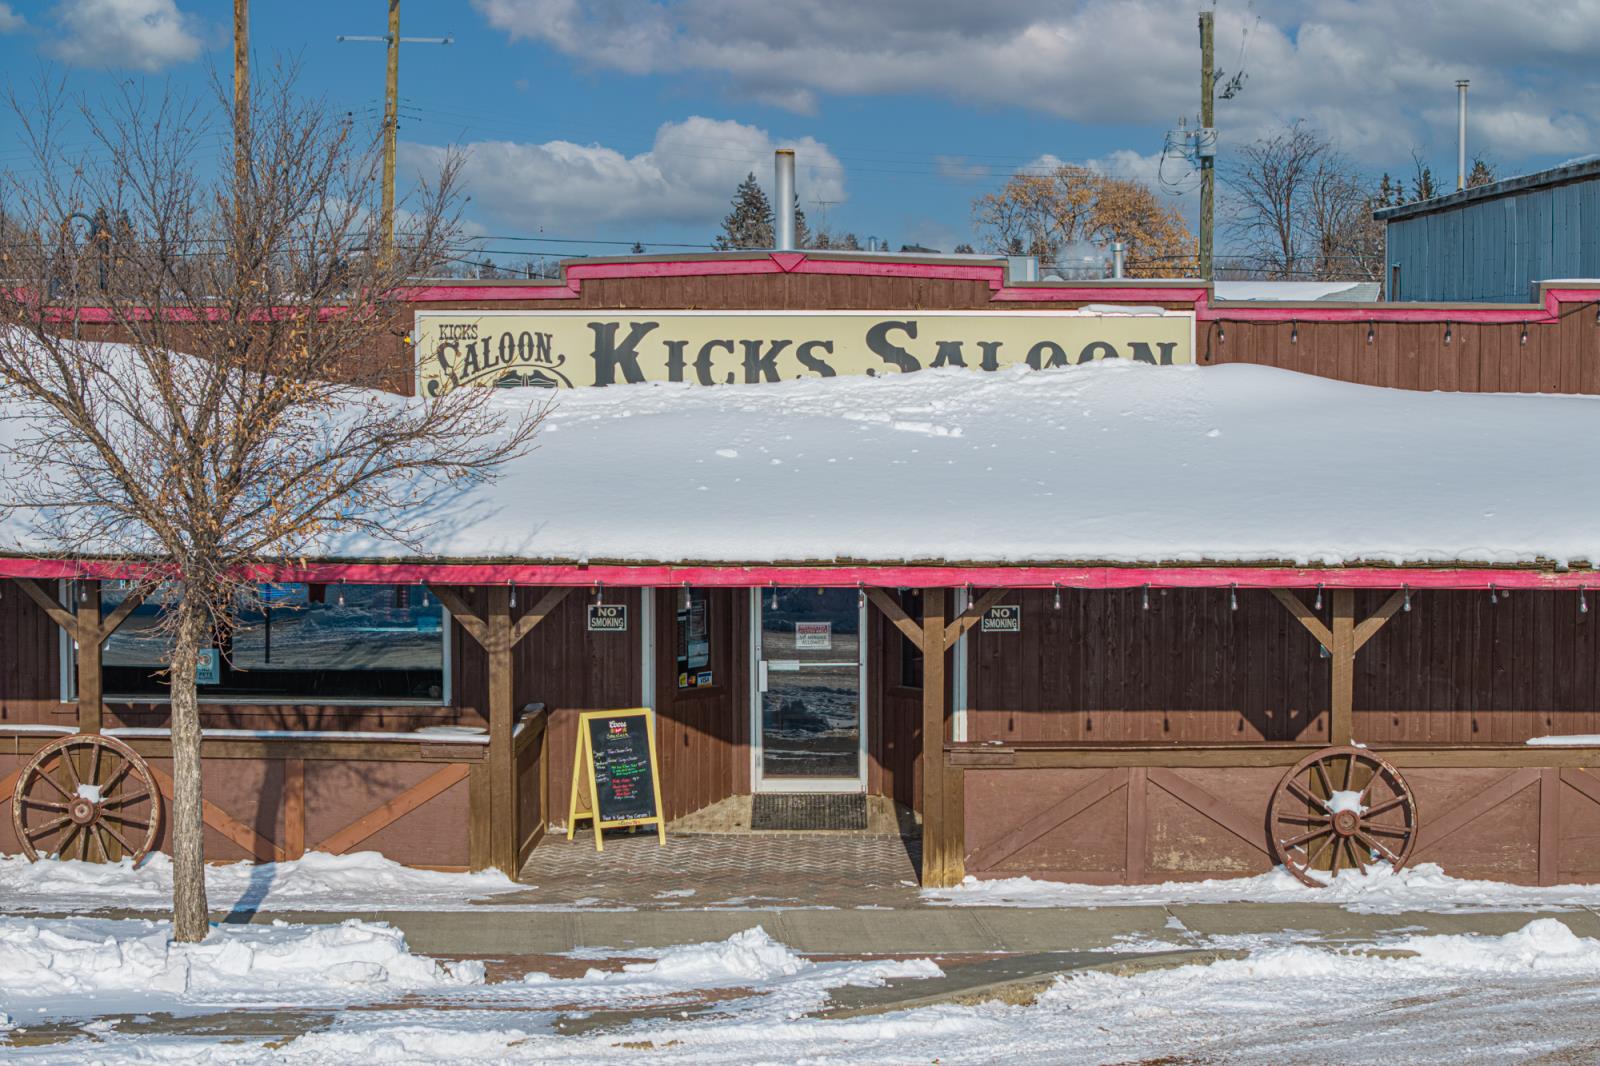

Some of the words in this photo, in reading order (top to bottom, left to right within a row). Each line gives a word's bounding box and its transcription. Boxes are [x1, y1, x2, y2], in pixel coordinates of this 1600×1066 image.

[438, 324, 479, 341] KICKS
[586, 321, 837, 388] KICKS
[432, 331, 554, 391] SALOON
[597, 607, 617, 617] NO
[991, 608, 1010, 618] NO
[591, 617, 624, 628] SMOKING
[984, 618, 1017, 629] SMOKING
